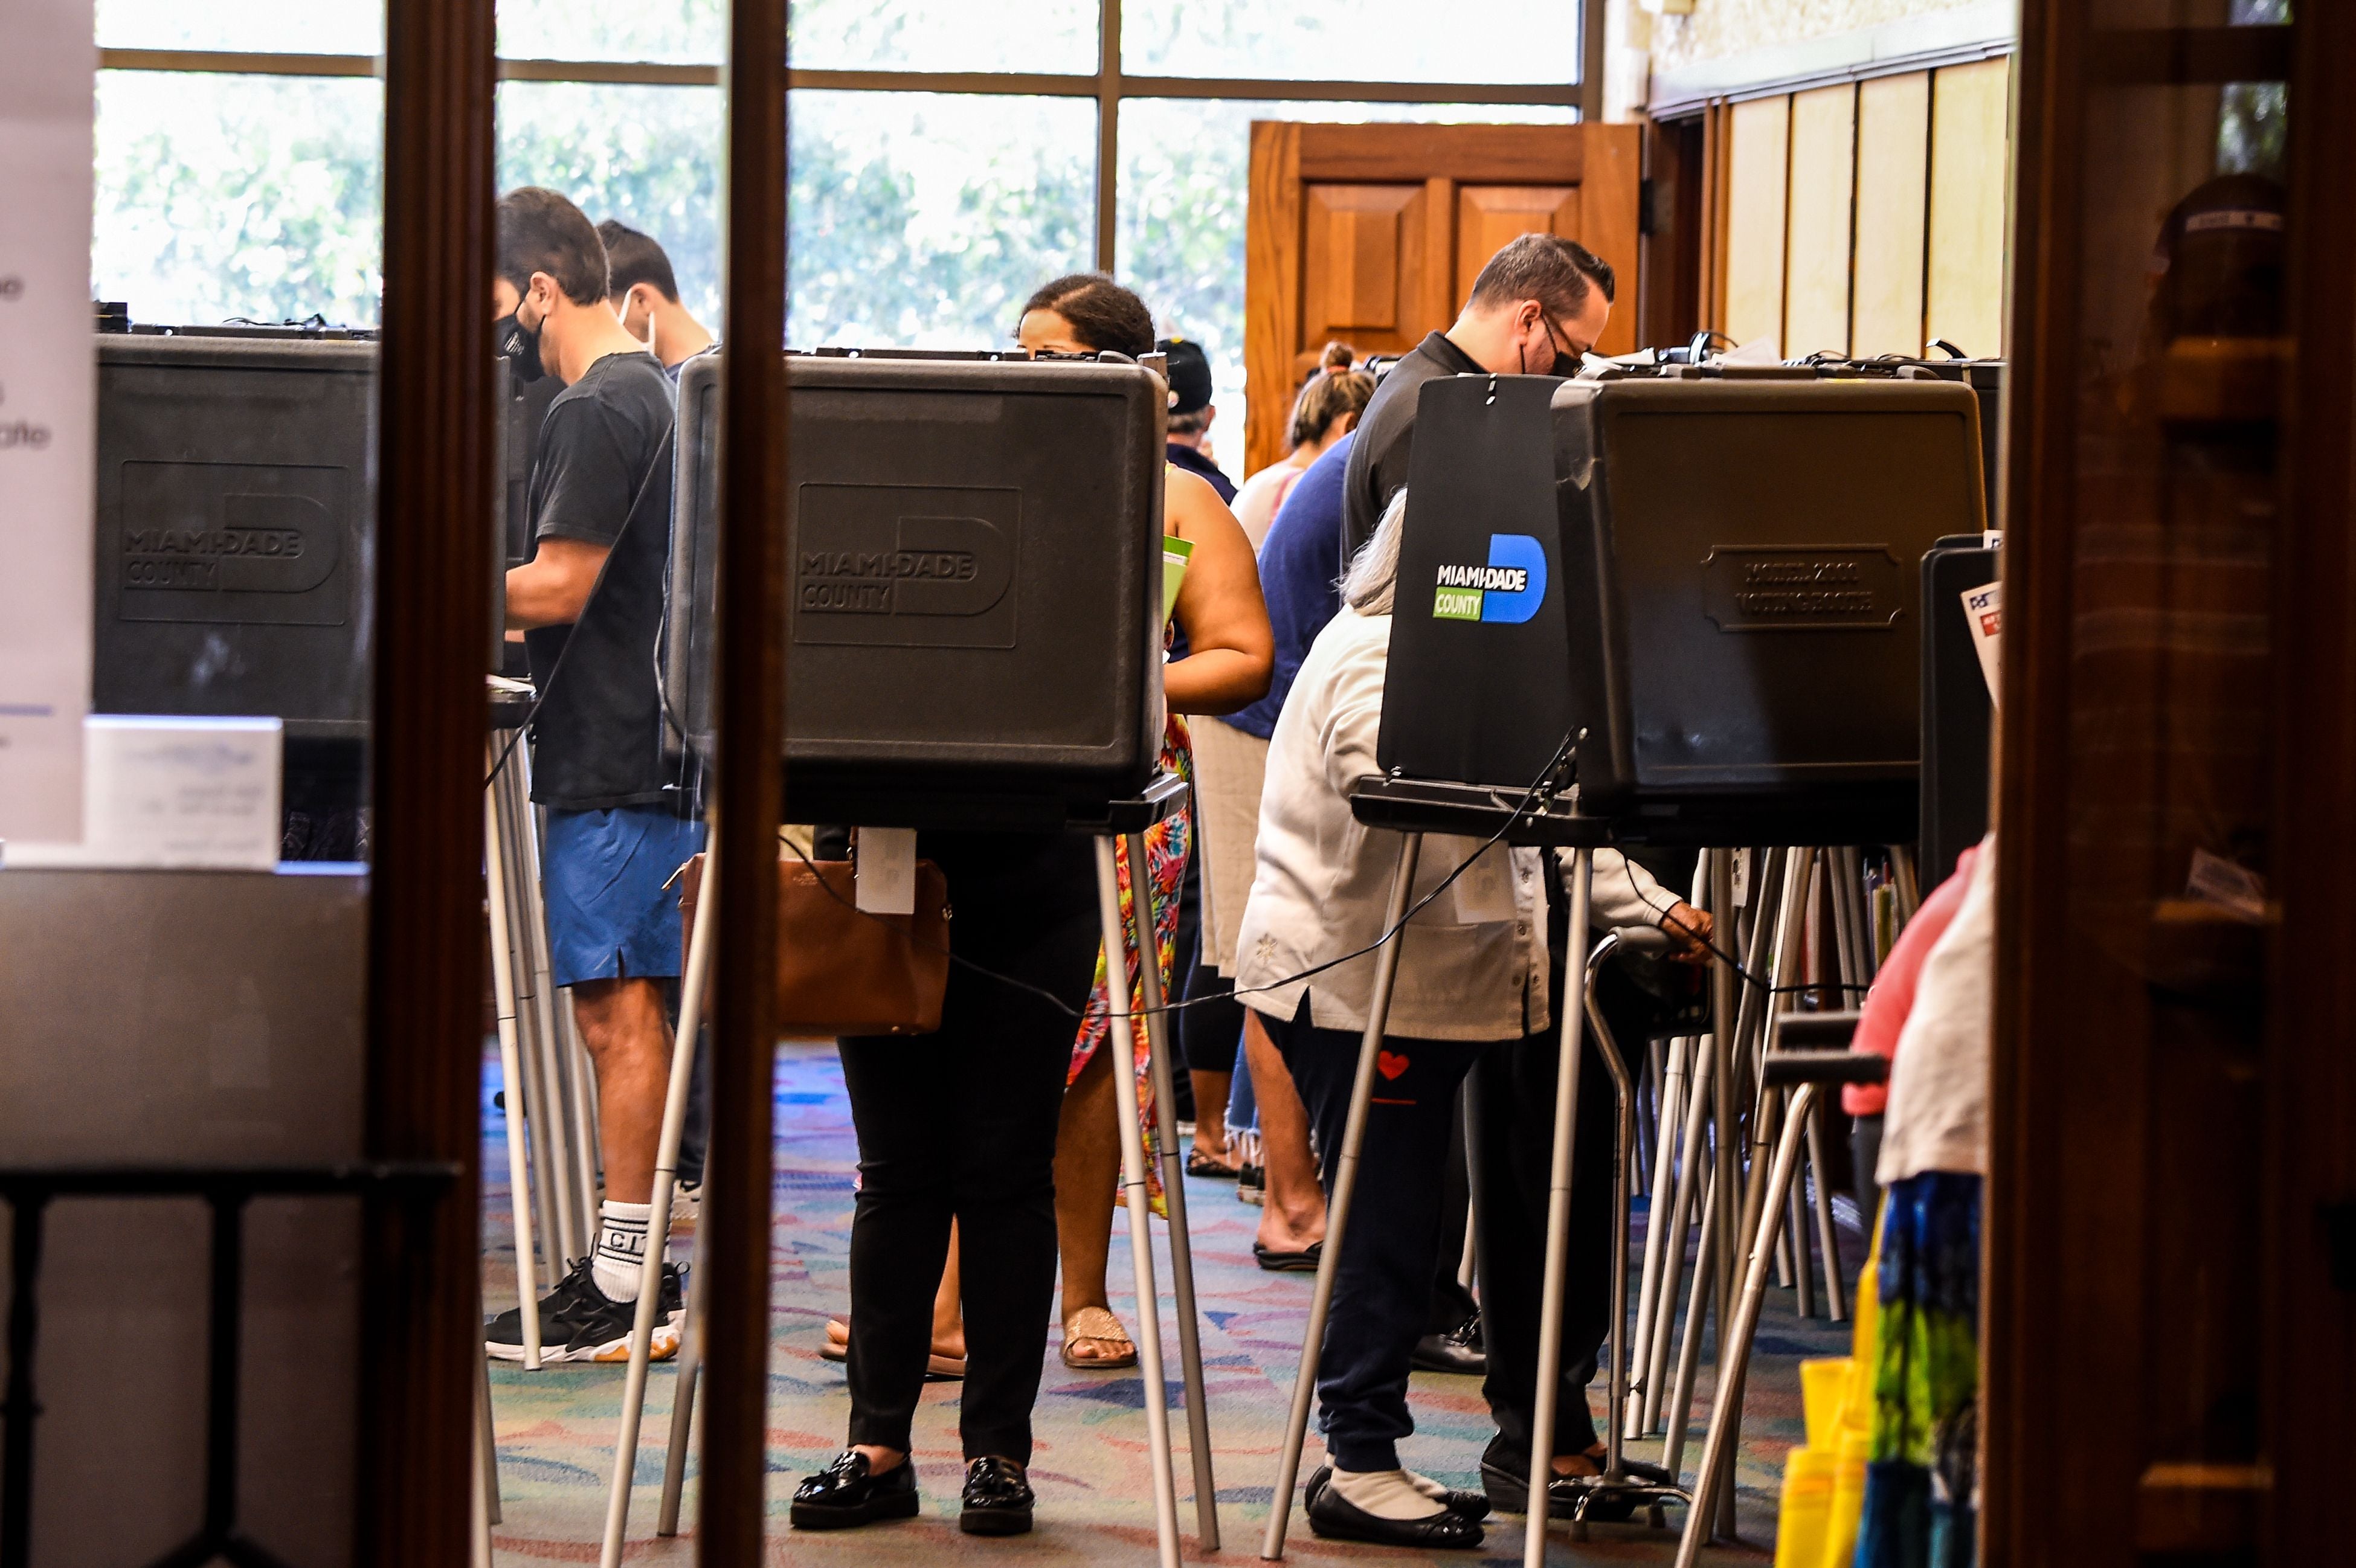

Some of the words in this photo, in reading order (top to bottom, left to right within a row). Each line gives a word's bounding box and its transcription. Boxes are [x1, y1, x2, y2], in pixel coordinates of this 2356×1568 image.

[124, 530, 300, 557] MIAMI-DADE
[127, 561, 216, 585] COUNTY
[800, 552, 975, 580] MIAMI-DADE
[1437, 565, 1527, 591] MIAMI-DADE
[1745, 563, 1811, 585] MODEL
[803, 585, 890, 609] COUNTY
[1435, 594, 1481, 615] COUNTY
[1735, 591, 1809, 614] VOTING
[611, 1232, 646, 1251] CI
